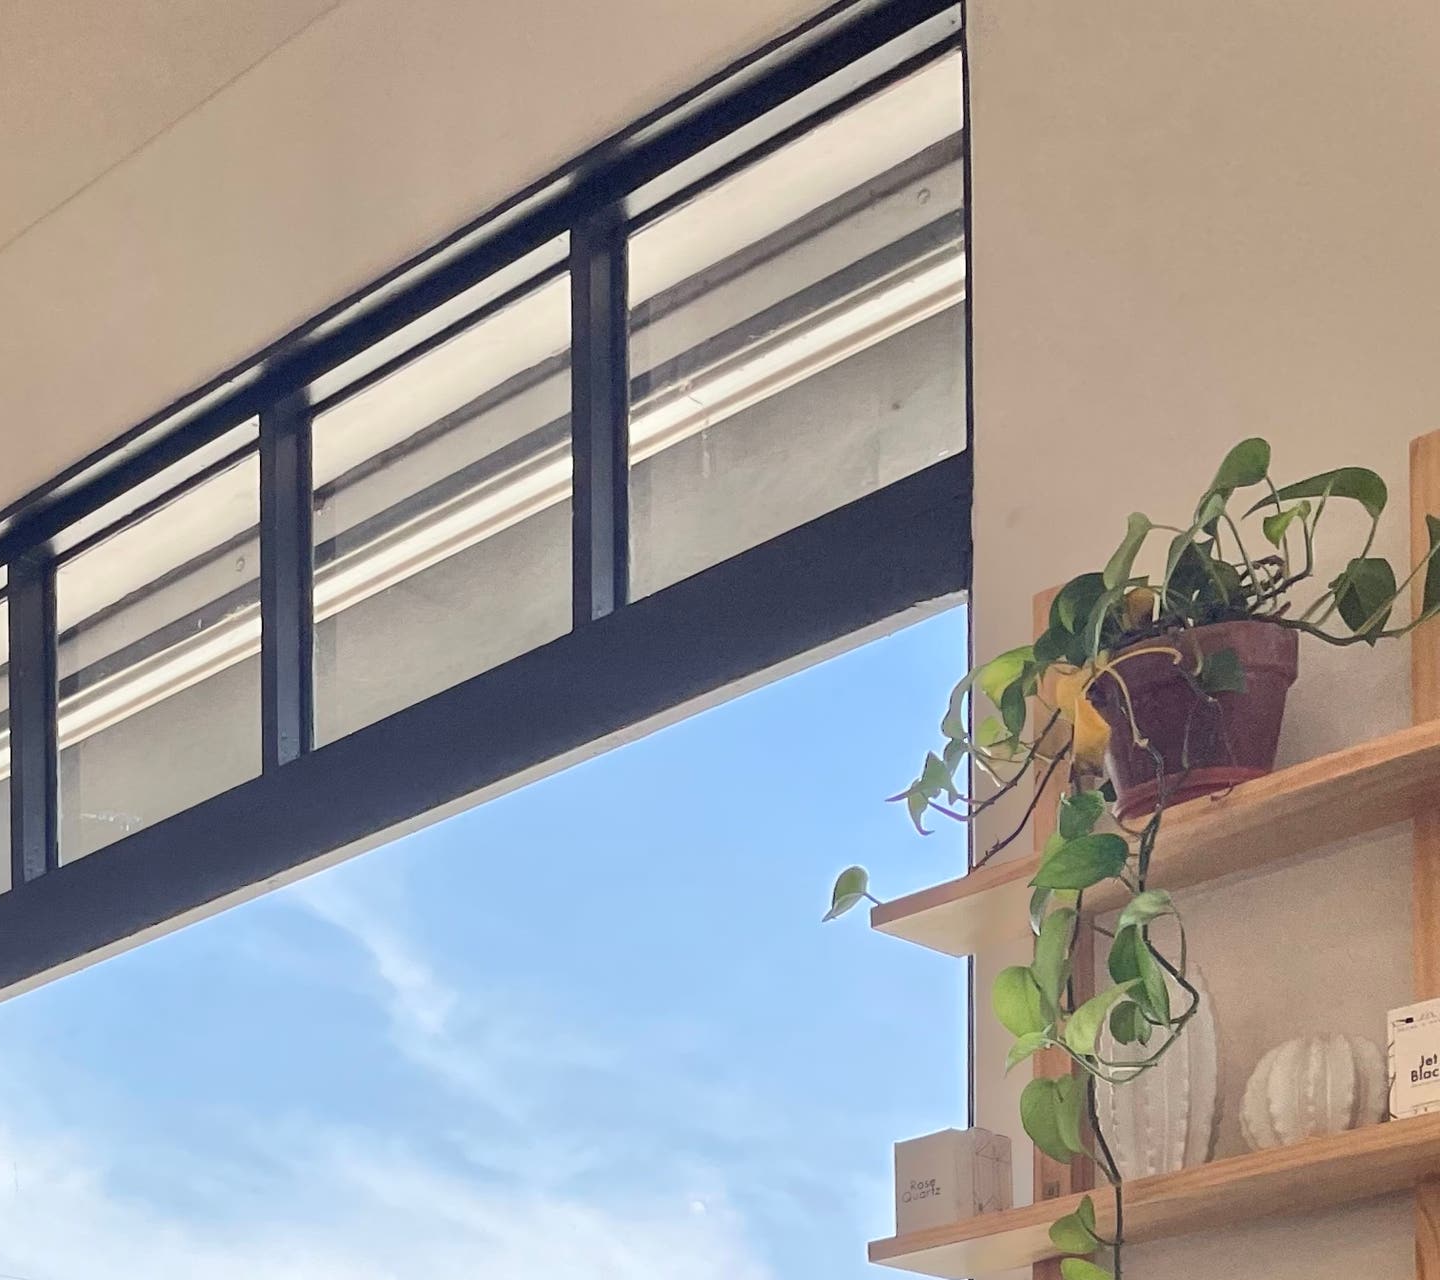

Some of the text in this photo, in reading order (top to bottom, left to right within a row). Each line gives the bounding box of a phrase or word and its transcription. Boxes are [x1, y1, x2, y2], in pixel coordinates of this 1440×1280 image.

[1420, 1054, 1438, 1069] Jet
[910, 1178, 936, 1191] Rose
[901, 1186, 941, 1203] Quartz
